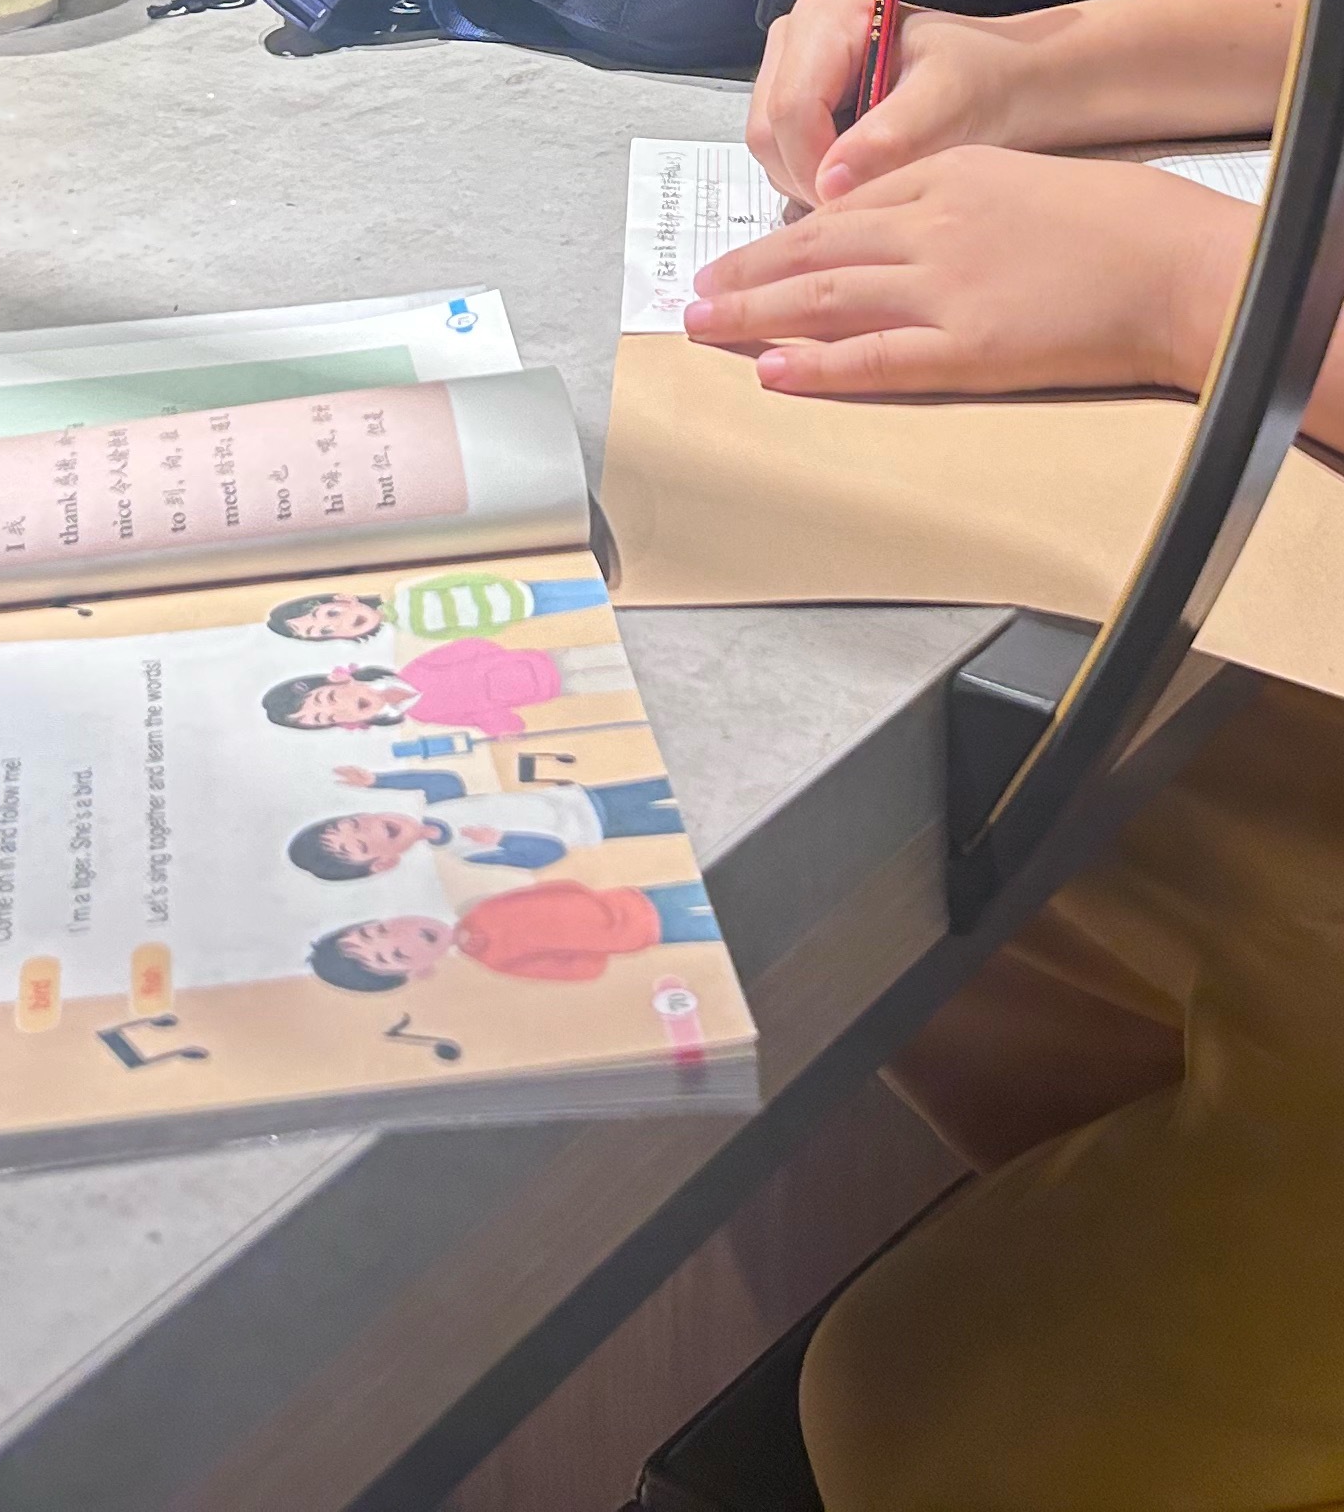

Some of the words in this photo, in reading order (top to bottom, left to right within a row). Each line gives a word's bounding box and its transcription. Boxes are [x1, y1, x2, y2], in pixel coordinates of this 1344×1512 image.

[266, 464, 289, 483] 也
[222, 480, 240, 527] meet
[275, 488, 292, 521] too
[322, 494, 344, 515] hi
[374, 475, 397, 509] but
[2, 515, 27, 536] 我
[55, 491, 80, 545] thank
[111, 499, 133, 539] nice
[169, 512, 186, 533] to
[5, 542, 26, 553] I
[141, 660, 163, 701] words!
[142, 705, 163, 727] the
[143, 766, 165, 790] and
[143, 795, 170, 850] together
[146, 854, 171, 882] sing
